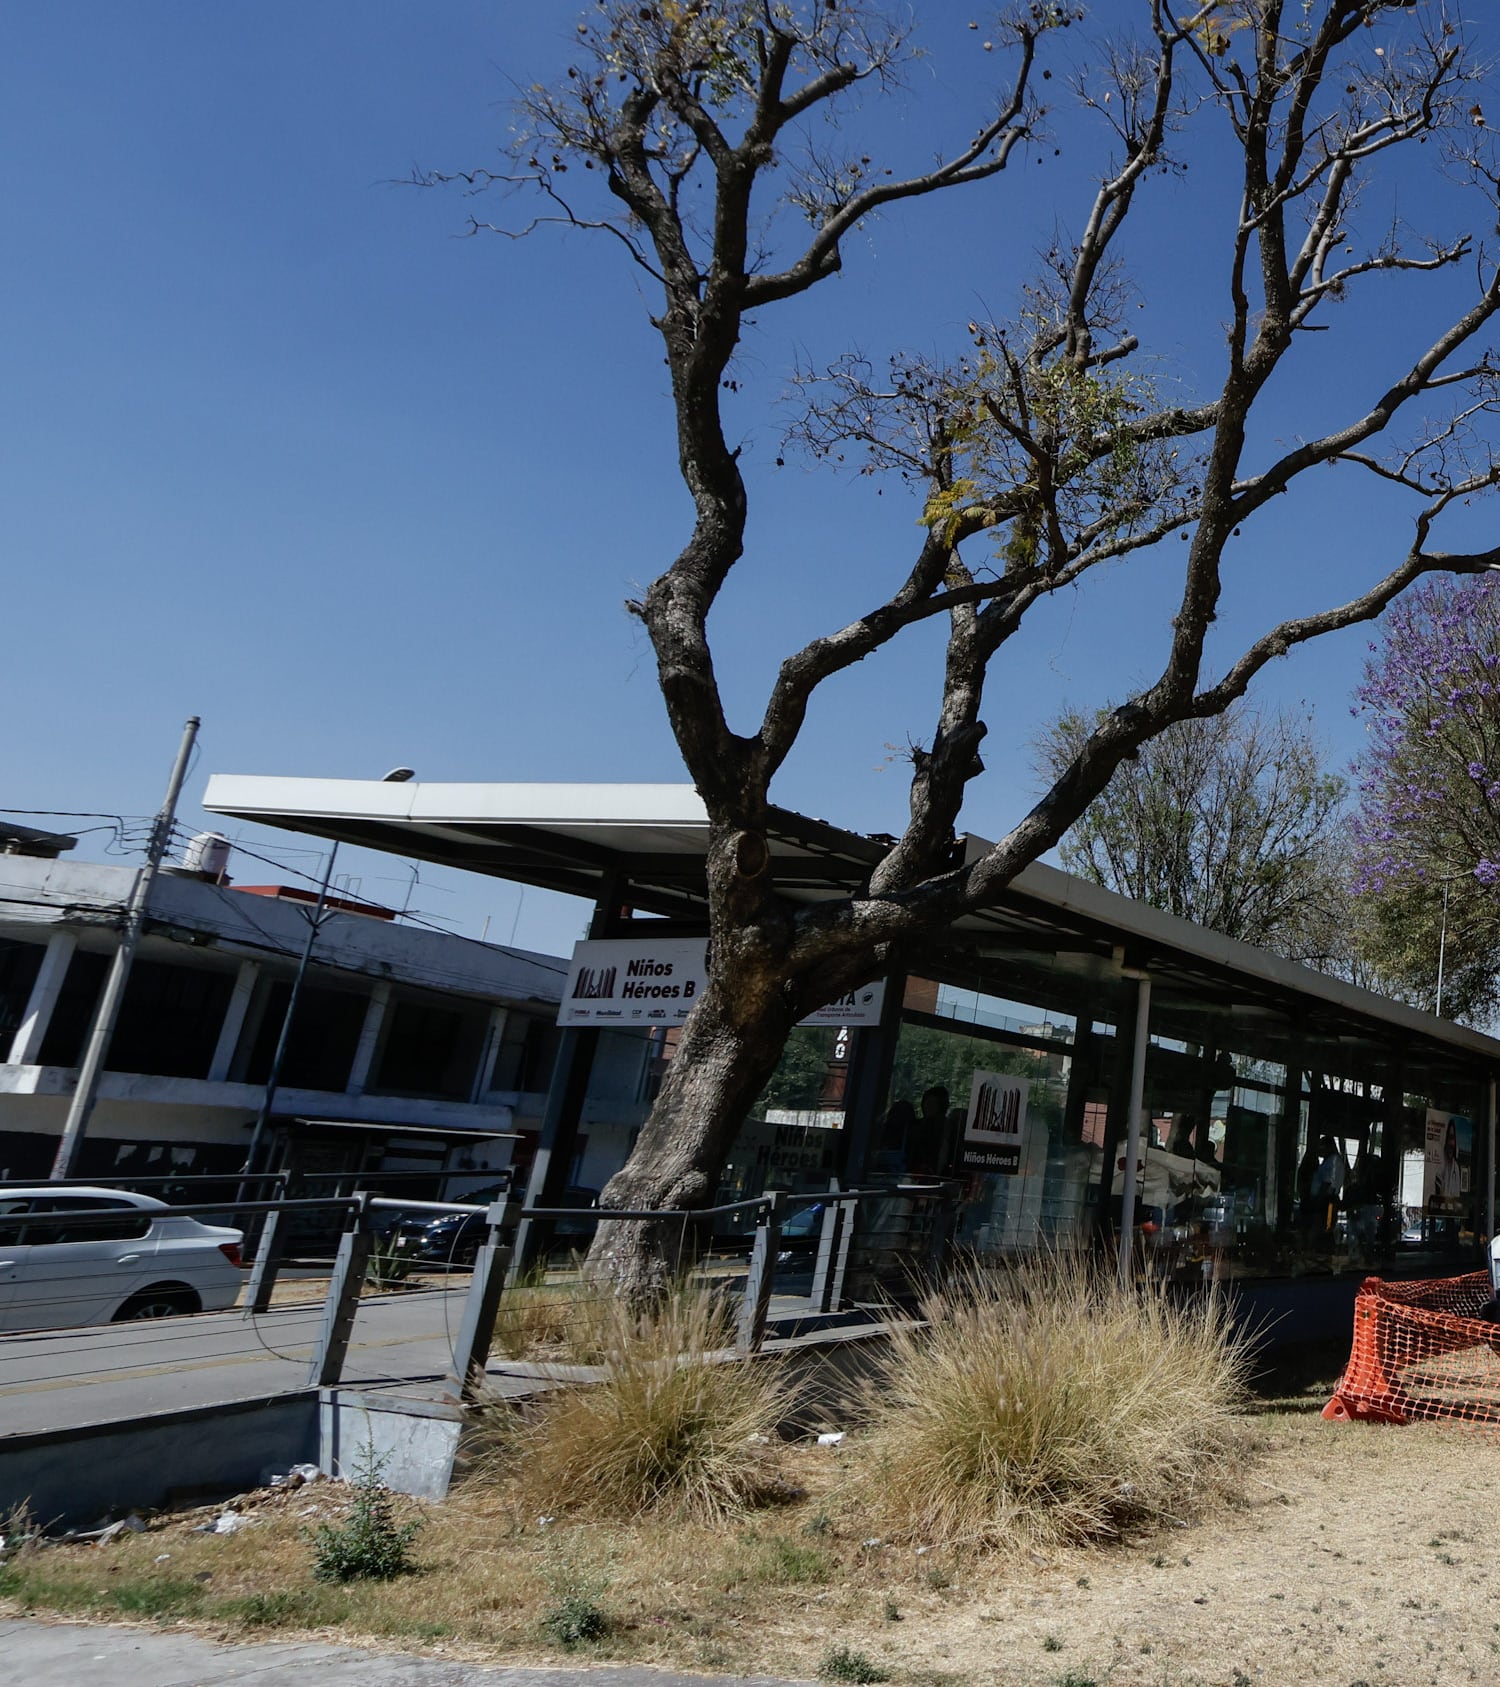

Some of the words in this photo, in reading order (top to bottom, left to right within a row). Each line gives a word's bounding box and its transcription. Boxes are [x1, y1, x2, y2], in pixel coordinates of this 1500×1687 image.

[627, 959, 673, 976] Niños
[622, 981, 680, 998] Héroes
[683, 981, 696, 998] B
[775, 1127, 822, 1148] Niños
[757, 1146, 818, 1168] Héroes
[964, 1151, 985, 1164] Niños
[986, 1154, 1011, 1166] Héroes
[1012, 1156, 1018, 1166] B
